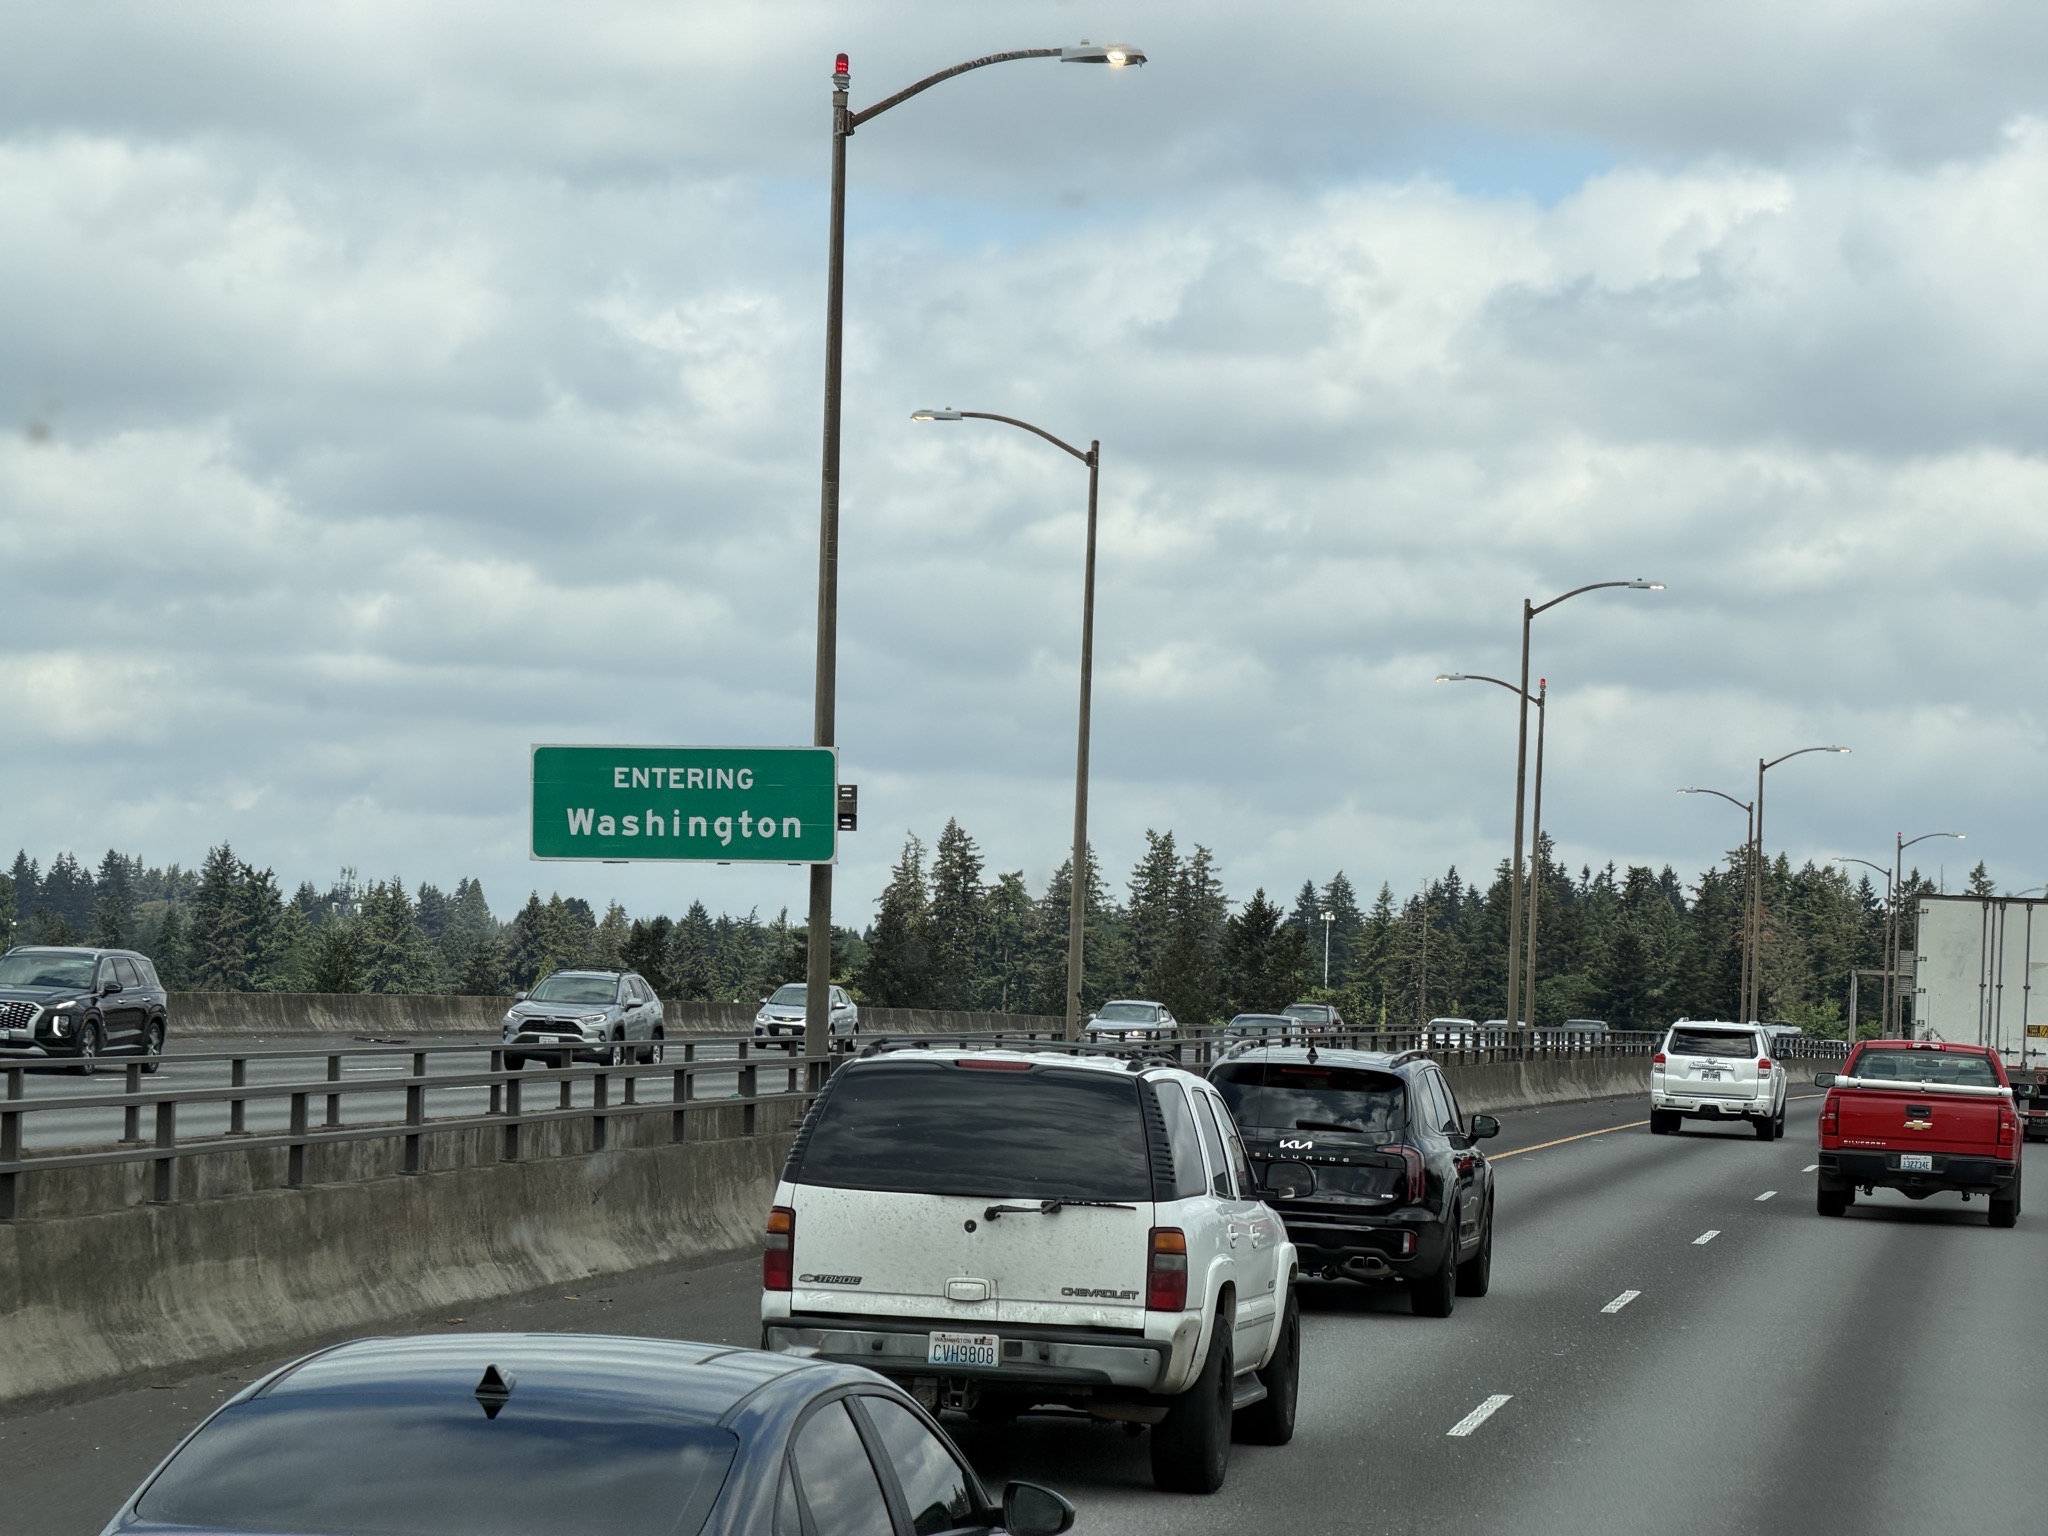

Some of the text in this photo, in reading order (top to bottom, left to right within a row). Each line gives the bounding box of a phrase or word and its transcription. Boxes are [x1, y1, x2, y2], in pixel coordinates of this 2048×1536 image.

[613, 767, 754, 790] ENTERING
[566, 807, 802, 848] Washington
[1280, 1139, 1313, 1150] KIA
[1254, 1152, 1350, 1163] ELLURIDE
[816, 1274, 862, 1285] TAHOE
[1061, 1287, 1139, 1300] CHEVROLET
[933, 1344, 994, 1365] CVH9808
